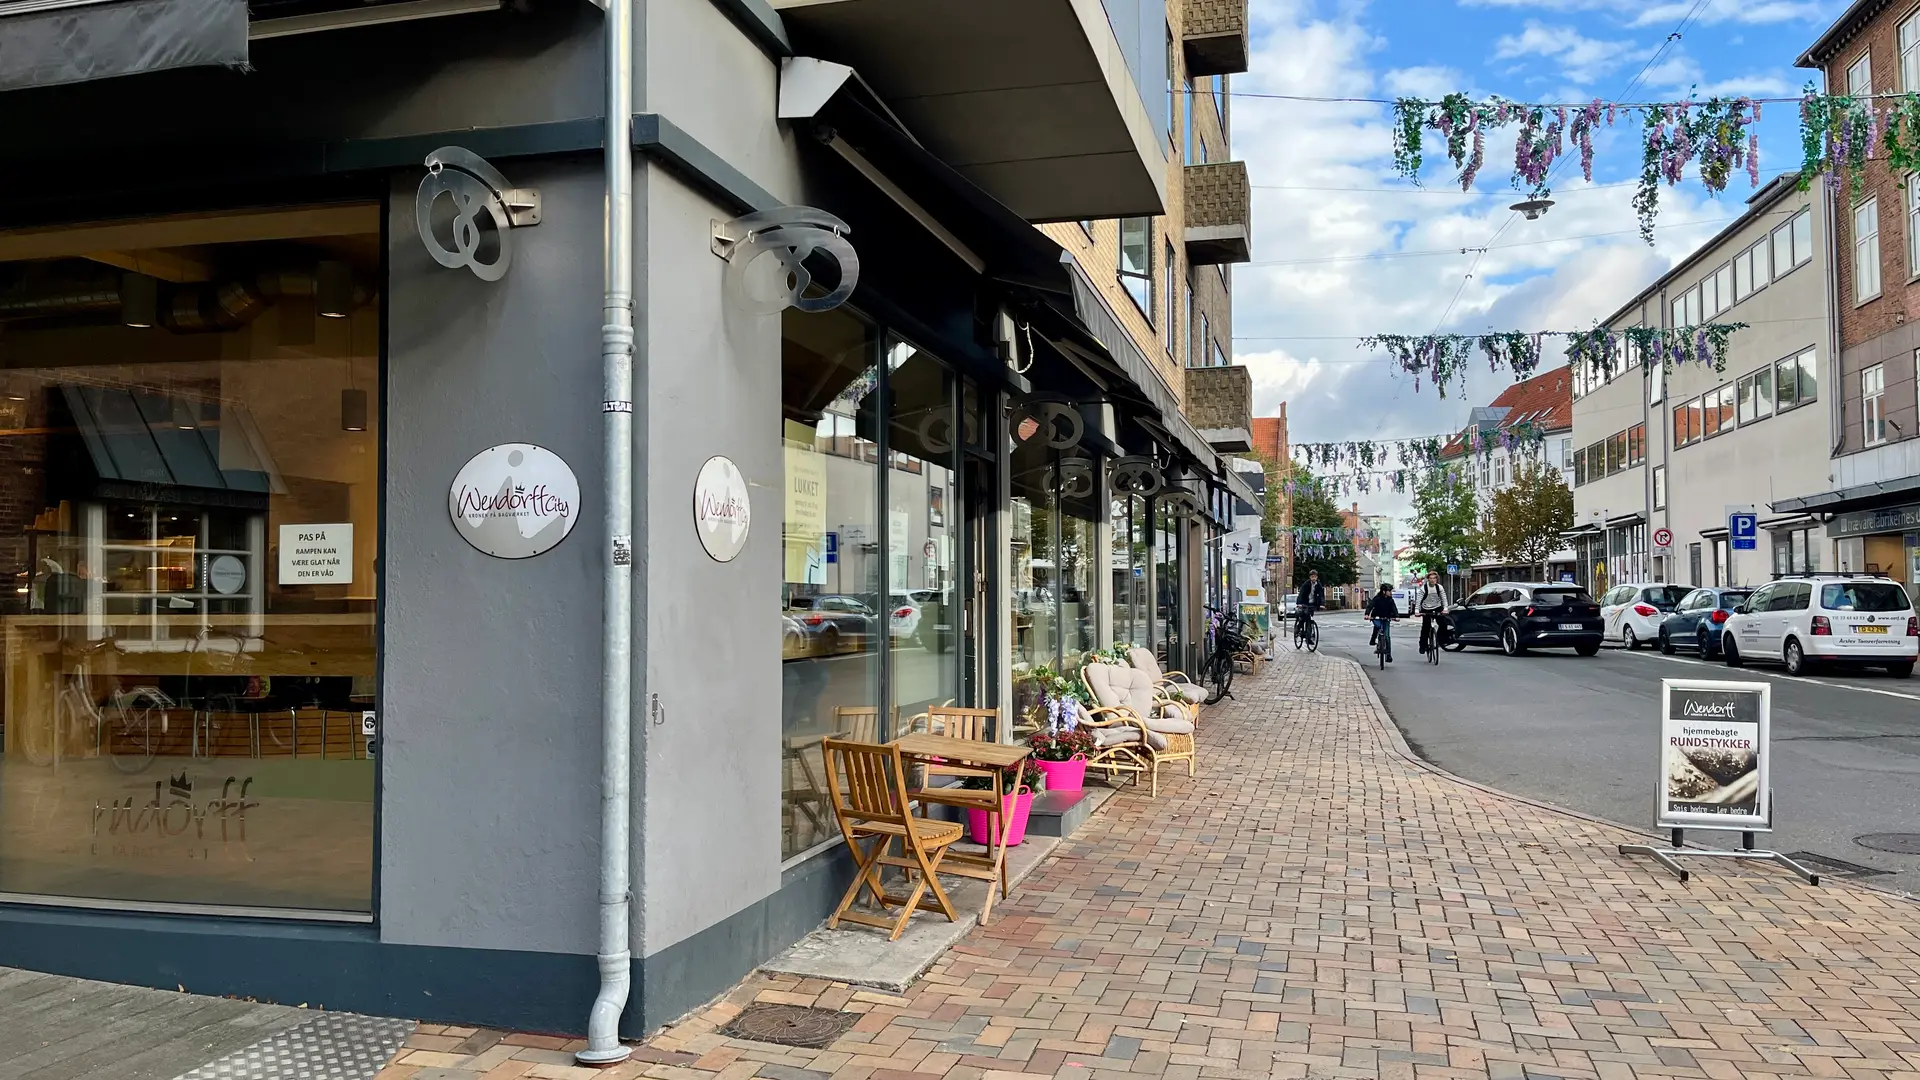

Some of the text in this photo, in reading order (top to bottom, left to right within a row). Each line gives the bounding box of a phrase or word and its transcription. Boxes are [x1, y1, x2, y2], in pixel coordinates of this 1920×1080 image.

[794, 477, 819, 497] LUKKET
[457, 484, 549, 519] Wendorff
[1737, 517, 1751, 535] P
[315, 531, 327, 541] PÅ
[326, 557, 341, 565] NÅR
[320, 569, 335, 577] VÅD
[1684, 699, 1736, 718] Wendorff
[1683, 727, 1739, 738] hjemmebagte
[1670, 736, 1751, 749] RUNDSTYKKER
[1716, 806, 1728, 814] Lev
[1730, 807, 1748, 815] bedre
